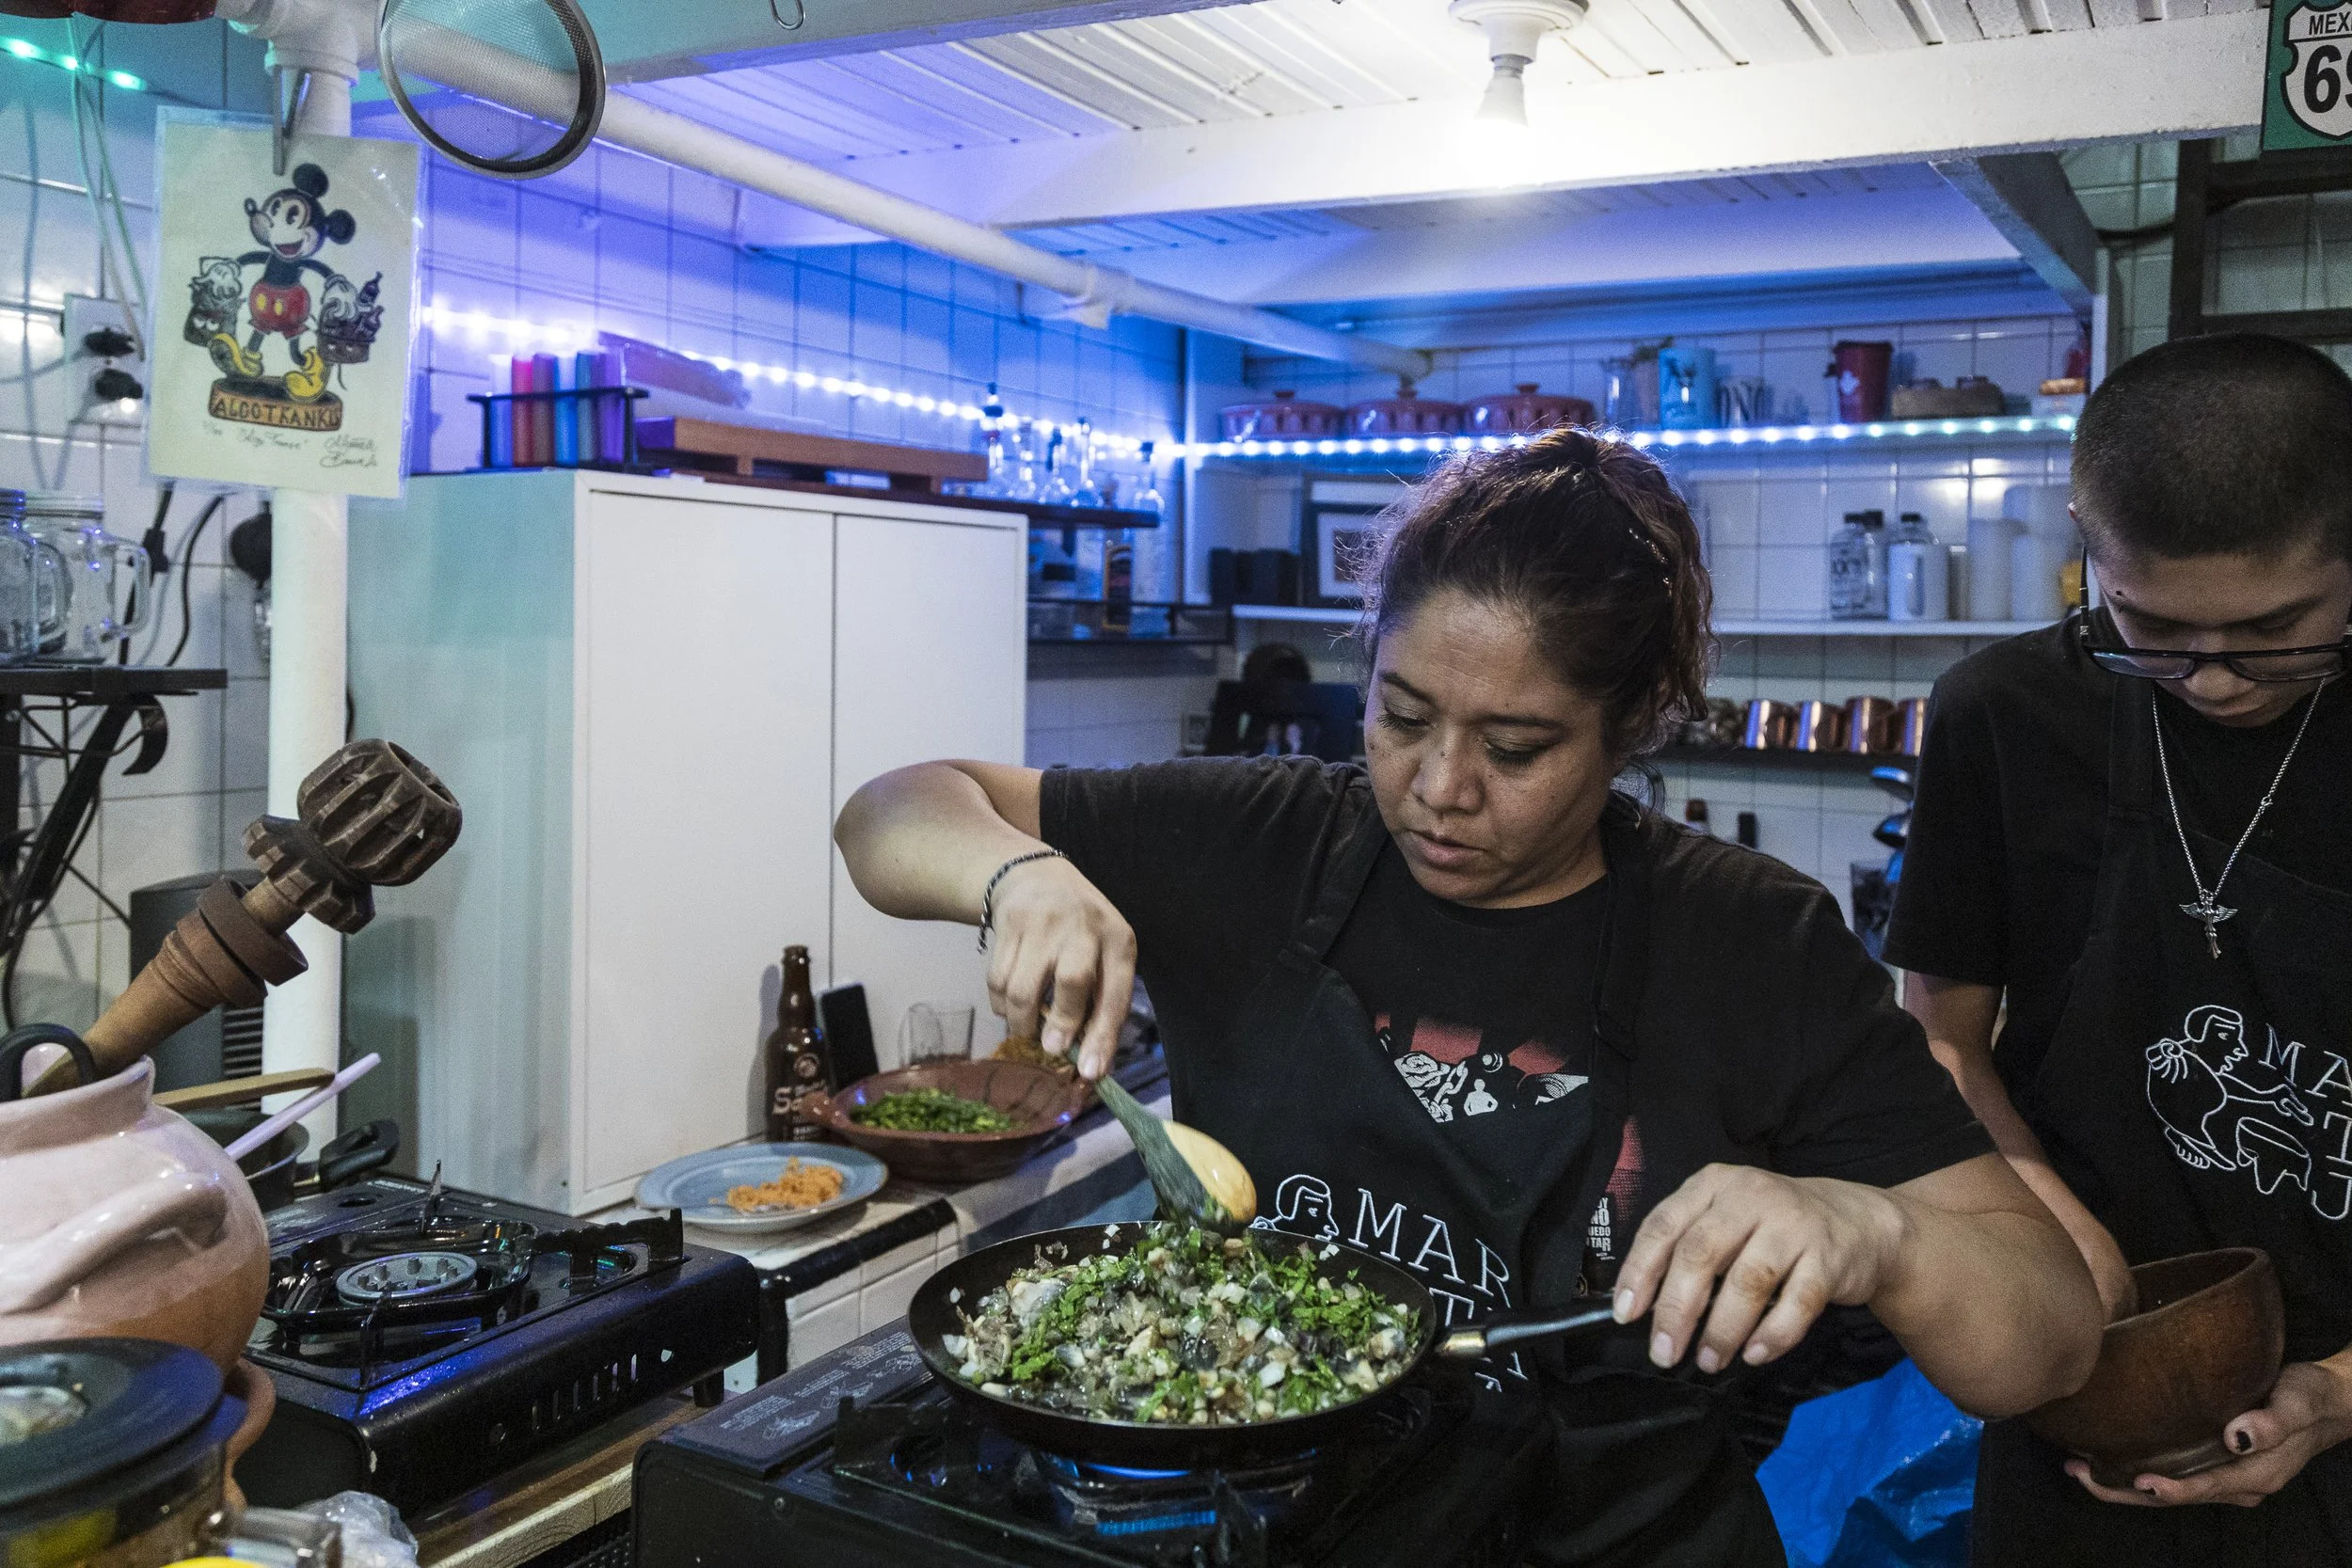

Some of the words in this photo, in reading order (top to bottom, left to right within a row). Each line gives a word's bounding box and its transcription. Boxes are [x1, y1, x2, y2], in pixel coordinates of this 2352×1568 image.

[2309, 11, 2352, 35] MEX
[2304, 45, 2352, 113] 6
[1347, 1188, 1511, 1308] MAR
[1585, 1237, 1611, 1252] TAR
